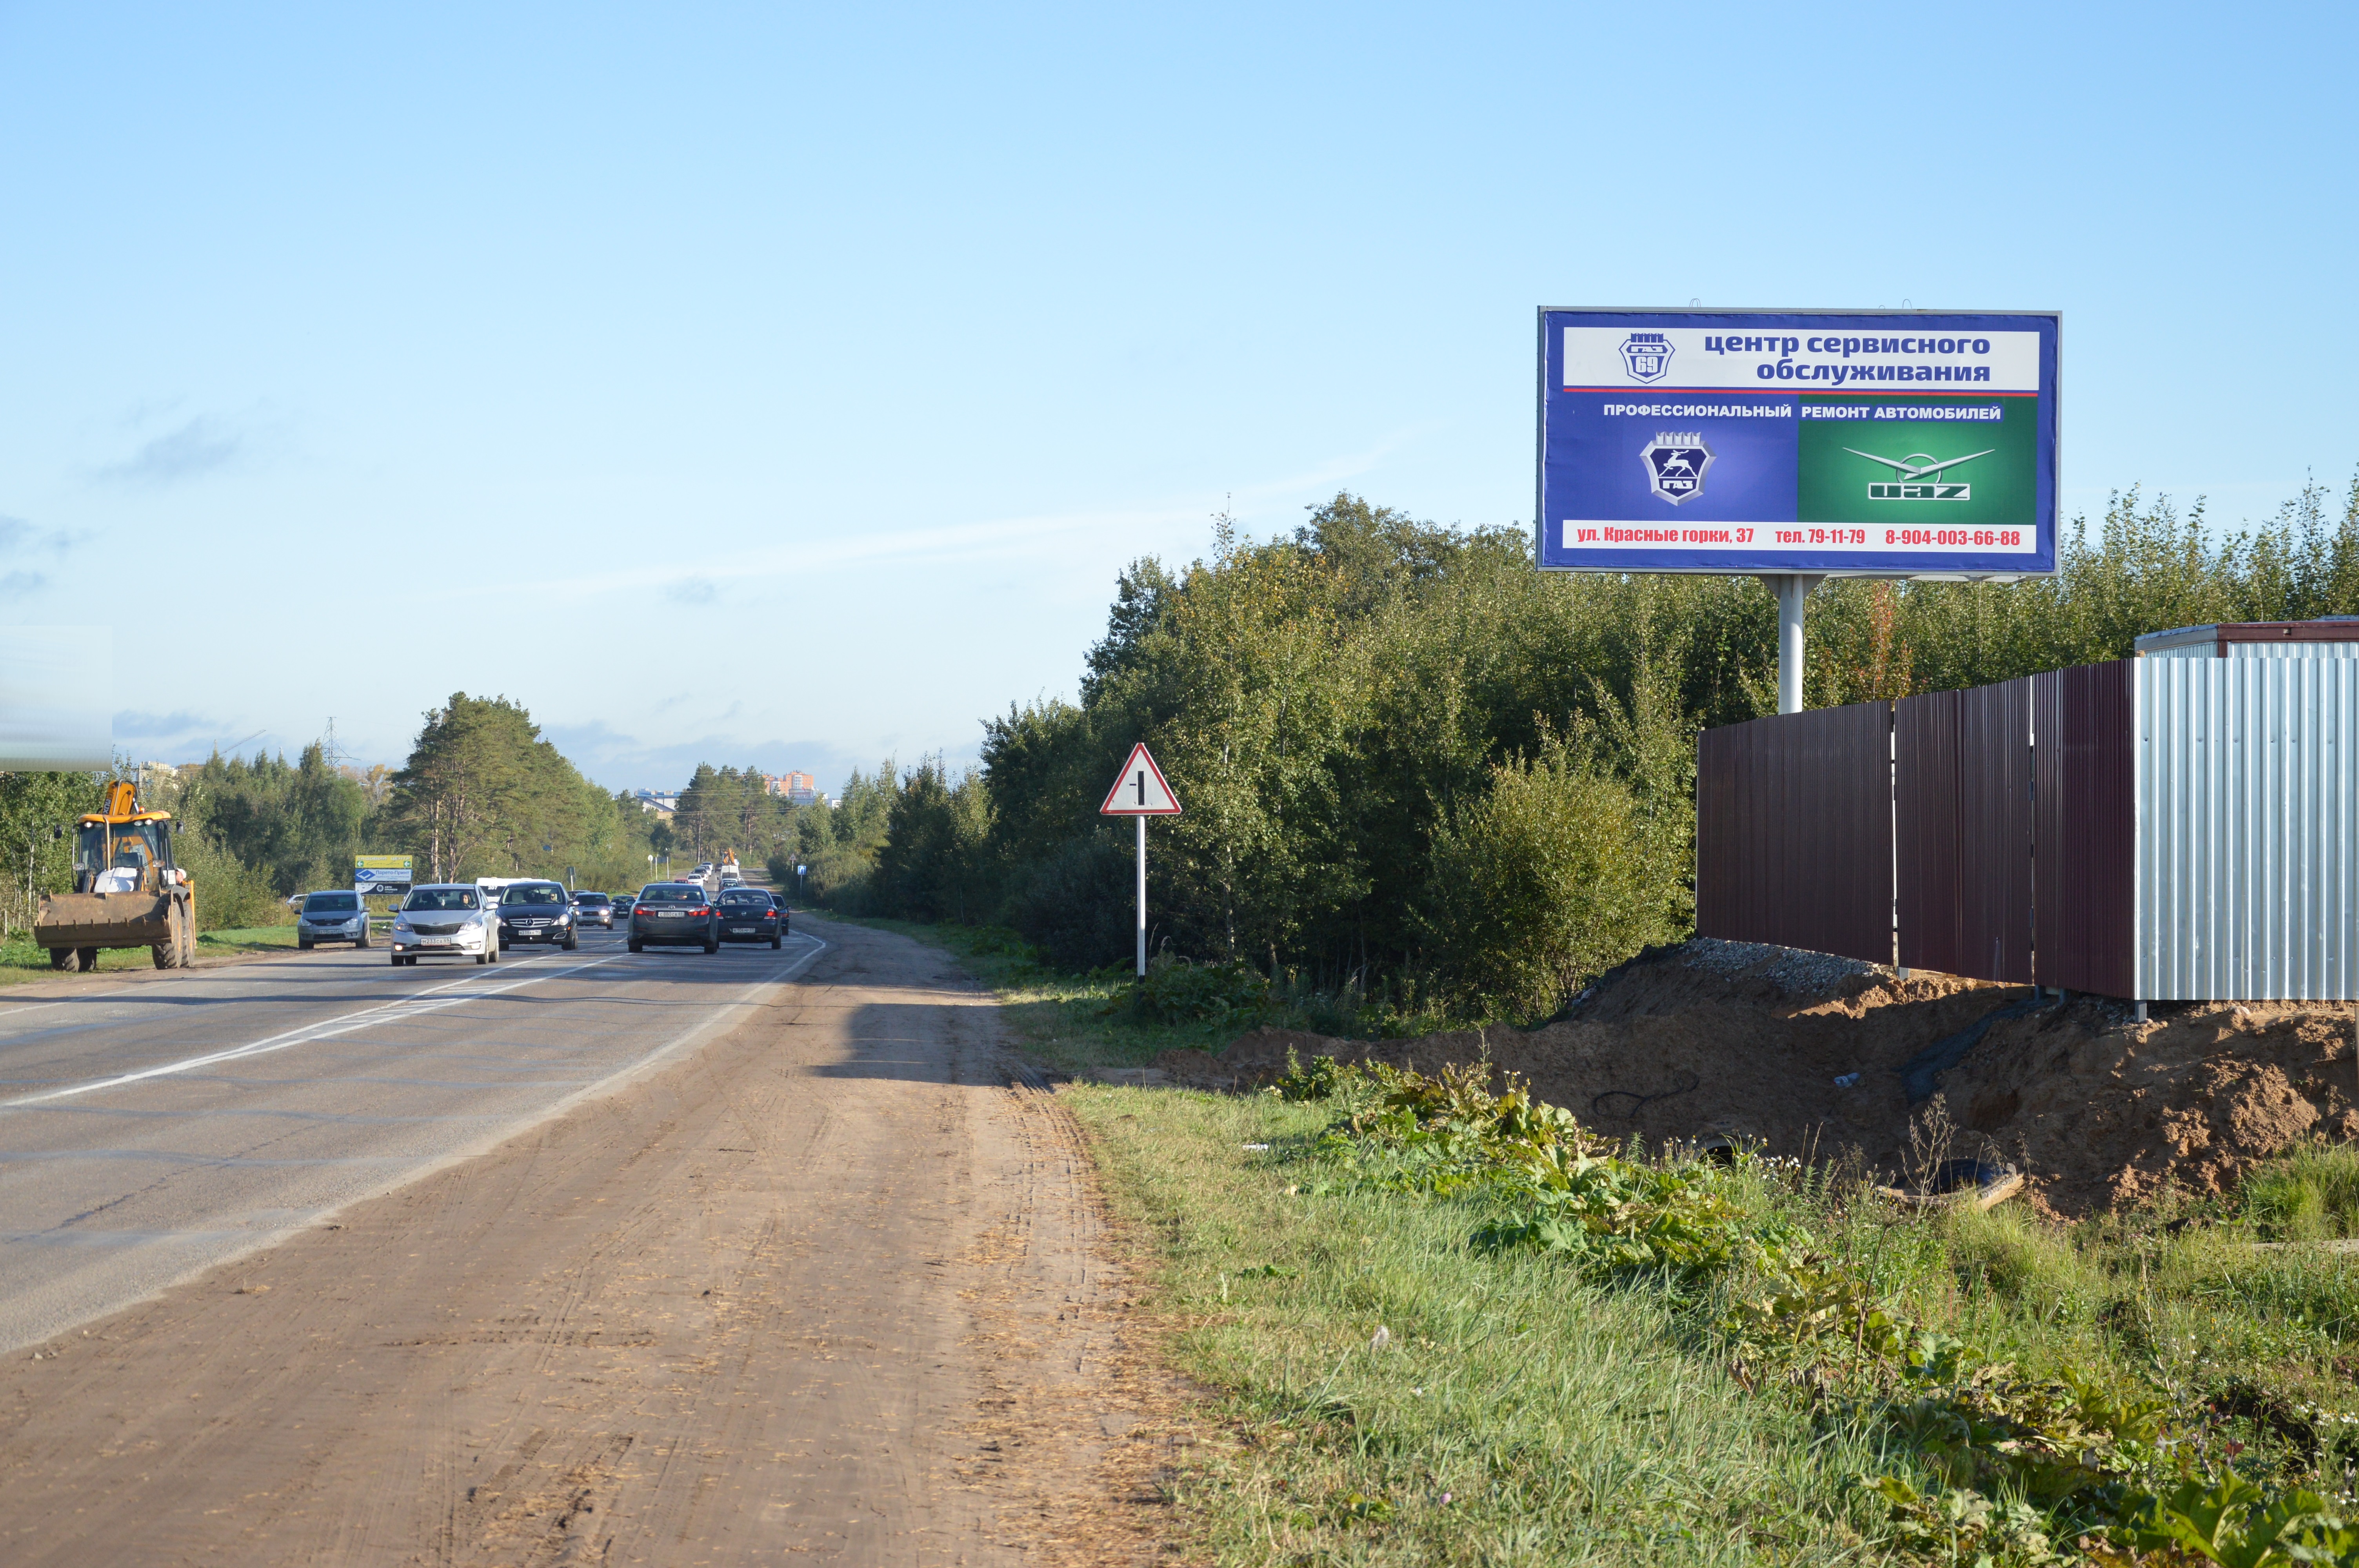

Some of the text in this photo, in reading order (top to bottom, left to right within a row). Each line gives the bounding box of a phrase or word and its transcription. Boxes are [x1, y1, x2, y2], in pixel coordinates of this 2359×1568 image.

[1705, 336, 1990, 358] центр сервисного
[1636, 356, 1658, 373] 69
[1757, 359, 1990, 385] обслуживания
[1604, 404, 2001, 419] ПРОФЕССИОНАЛЬНЫЙ РЕМОНТ АВТОМОБИЛЕЙ
[1663, 481, 1693, 489] ГАЗ
[1577, 527, 1754, 544] ул. Красные горки, 37
[1776, 528, 1865, 544] тел. 79-11-79
[1885, 530, 2020, 546] 8-904-003-66-88
